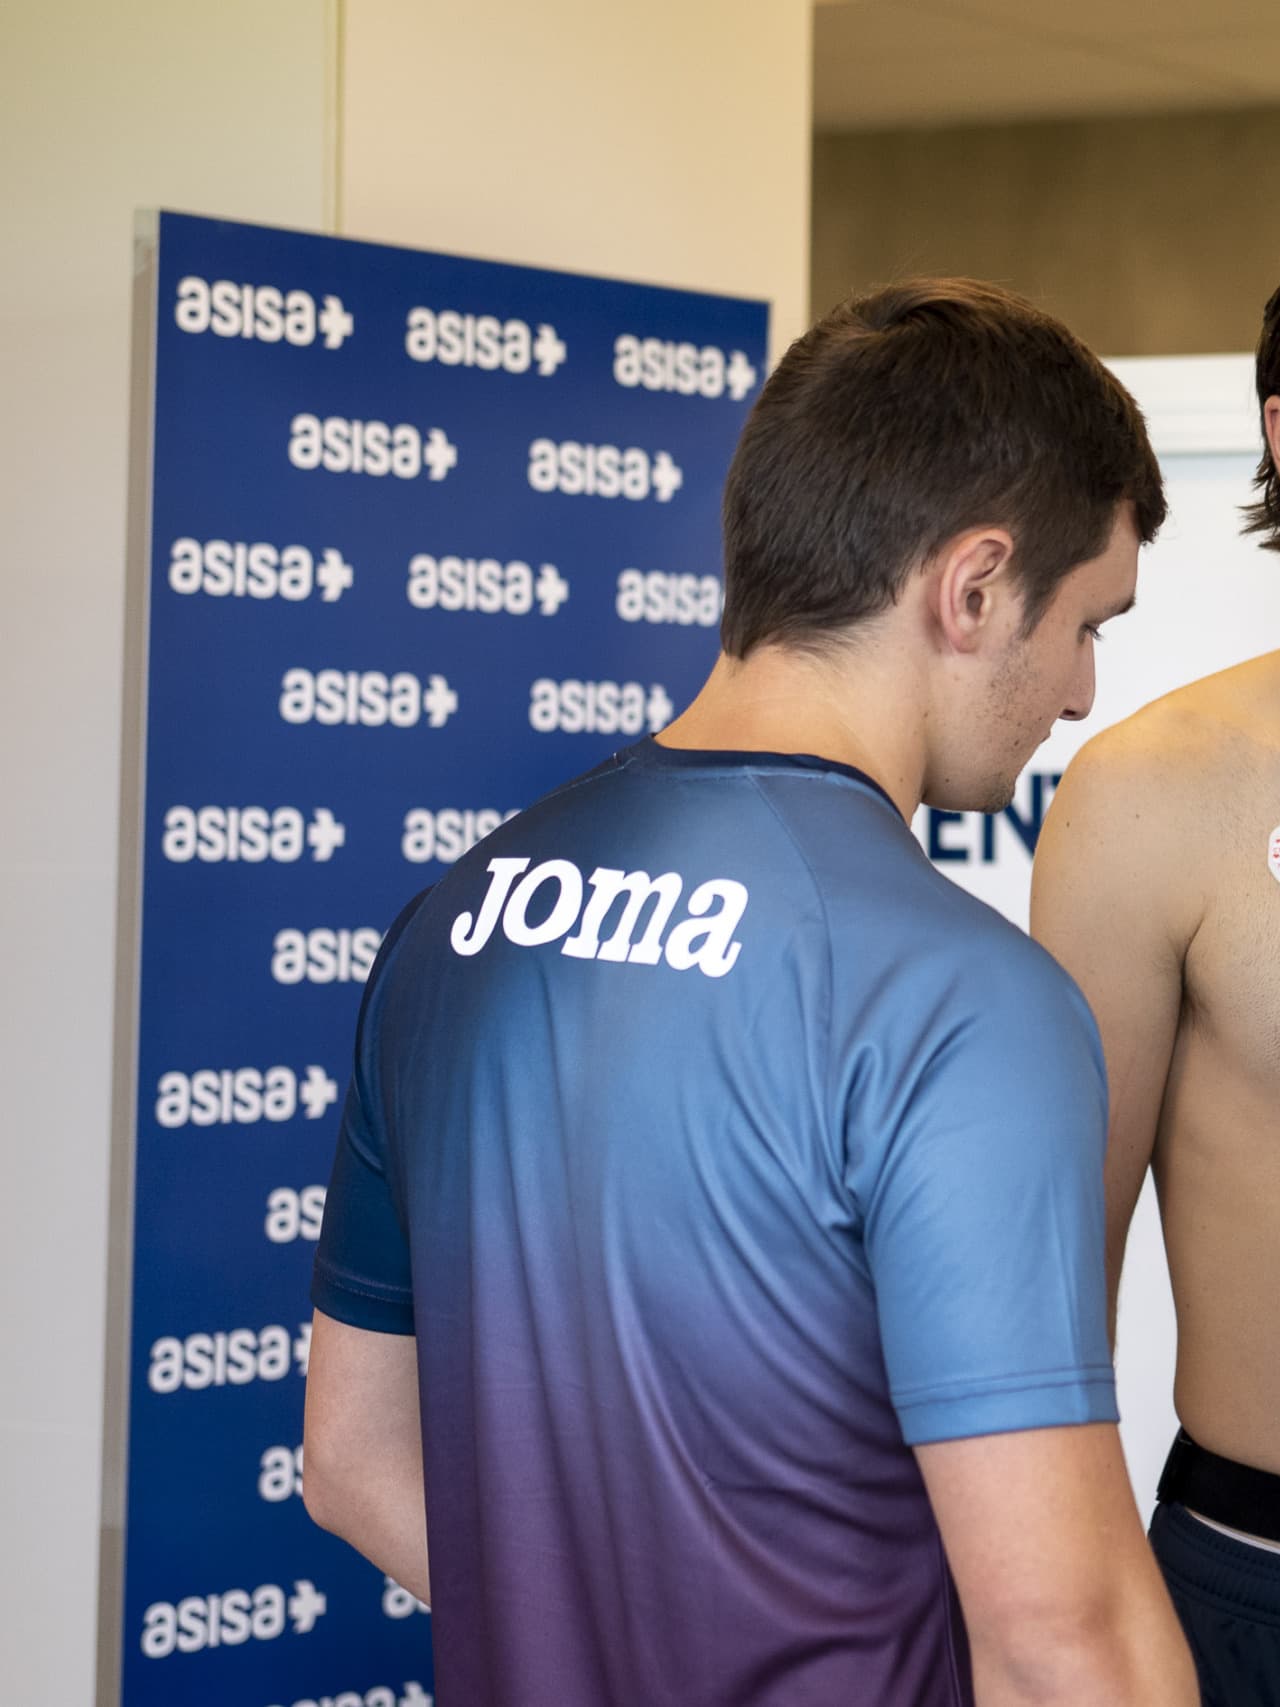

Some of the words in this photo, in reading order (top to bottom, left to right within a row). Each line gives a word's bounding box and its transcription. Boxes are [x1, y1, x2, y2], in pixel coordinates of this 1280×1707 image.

[175, 276, 316, 347] asisa
[405, 308, 531, 373] asisa
[614, 335, 725, 398] asisa
[289, 413, 420, 480] asisa
[528, 439, 650, 501] asisa
[169, 537, 313, 601] asisa
[408, 554, 533, 615] asisa
[616, 569, 720, 627] asisa
[280, 668, 422, 727] asisa
[529, 679, 643, 735] asisa
[162, 806, 304, 862] asisa
[402, 808, 521, 863] asis
[929, 773, 1064, 863] EN
[271, 927, 388, 984] asis
[156, 1066, 296, 1128] asisa
[149, 1325, 290, 1393] asisa
[142, 1585, 285, 1658] asisa
